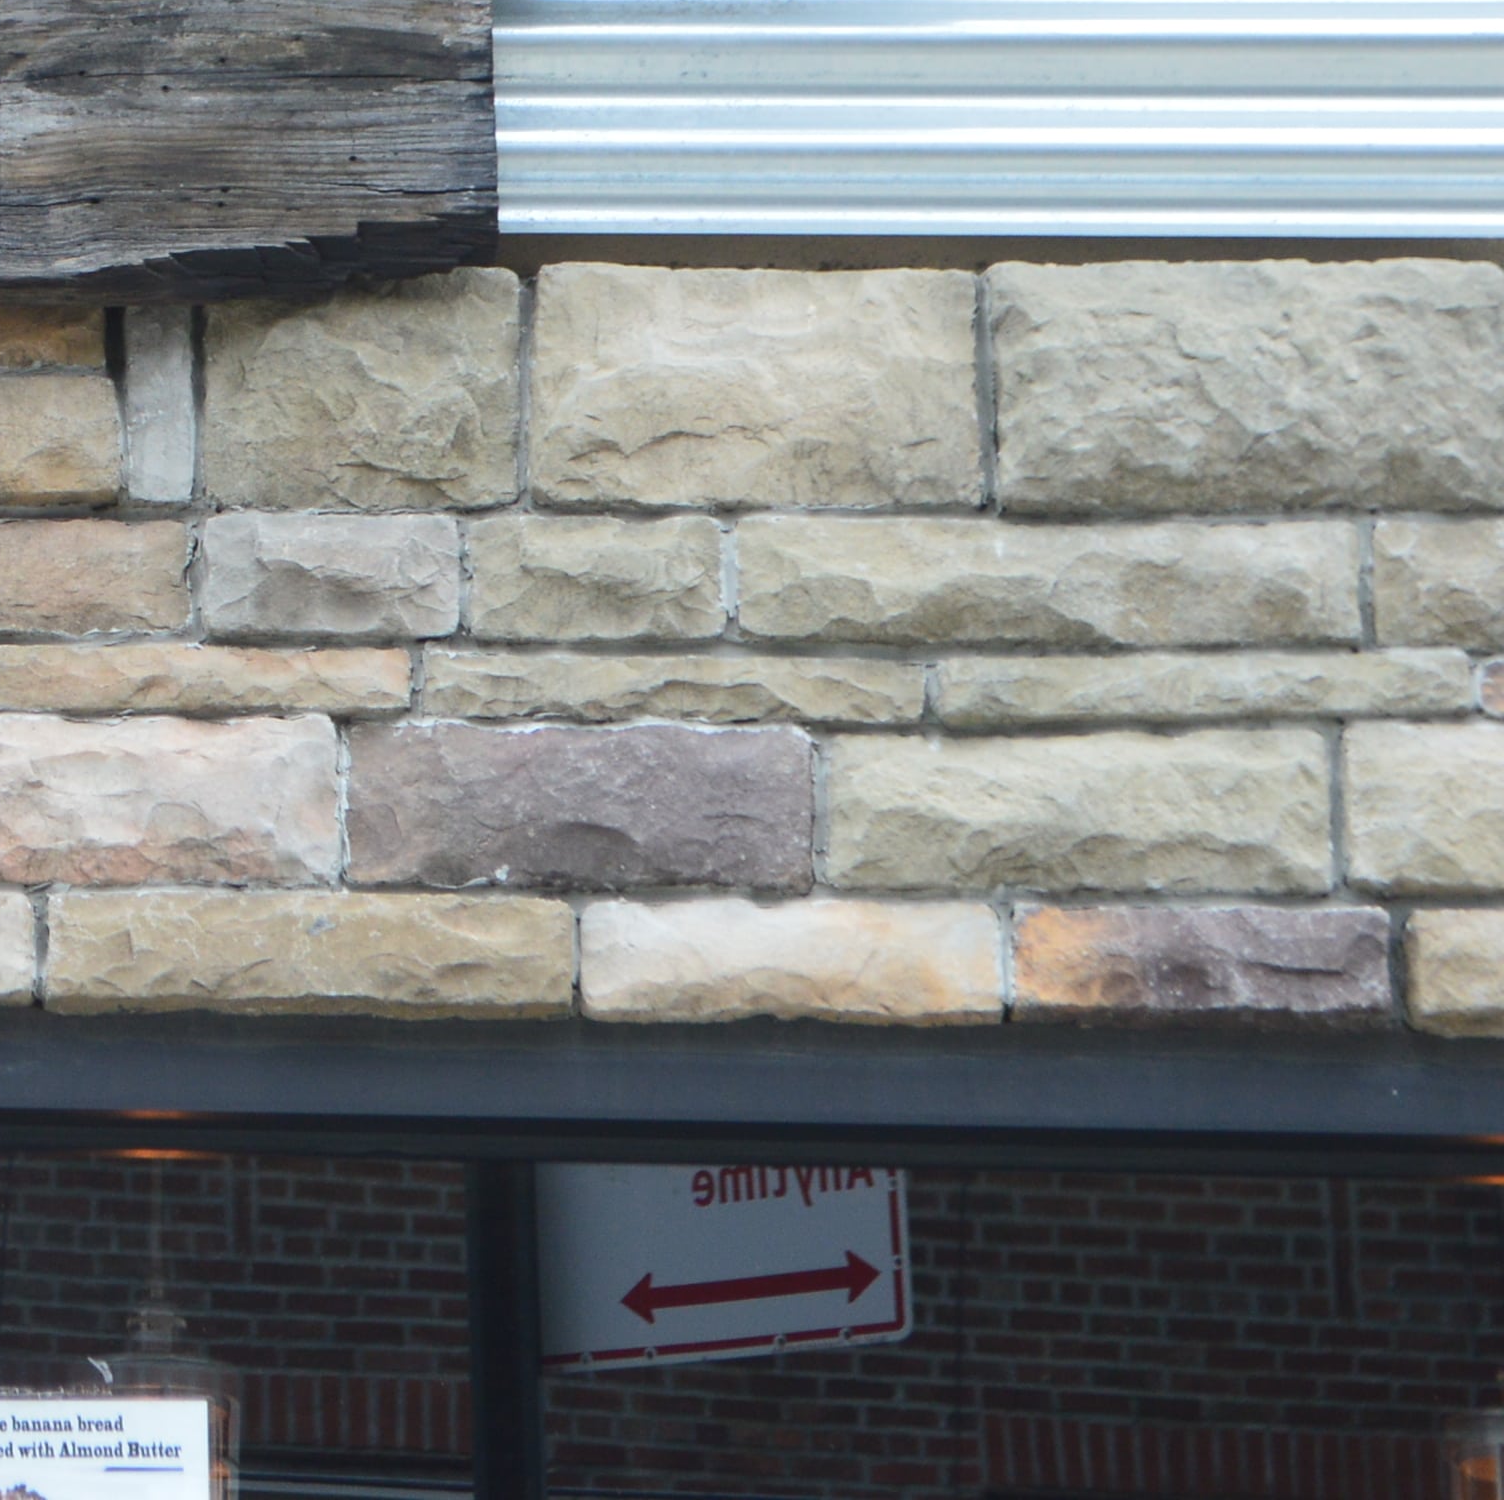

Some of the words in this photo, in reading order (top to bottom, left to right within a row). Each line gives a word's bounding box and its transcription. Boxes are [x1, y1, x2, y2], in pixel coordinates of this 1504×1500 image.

[11, 1414, 73, 1433] banana
[77, 1414, 124, 1433] bread
[18, 1441, 55, 1459] with
[59, 1441, 123, 1459] Almond
[127, 1441, 182, 1459] Butter
